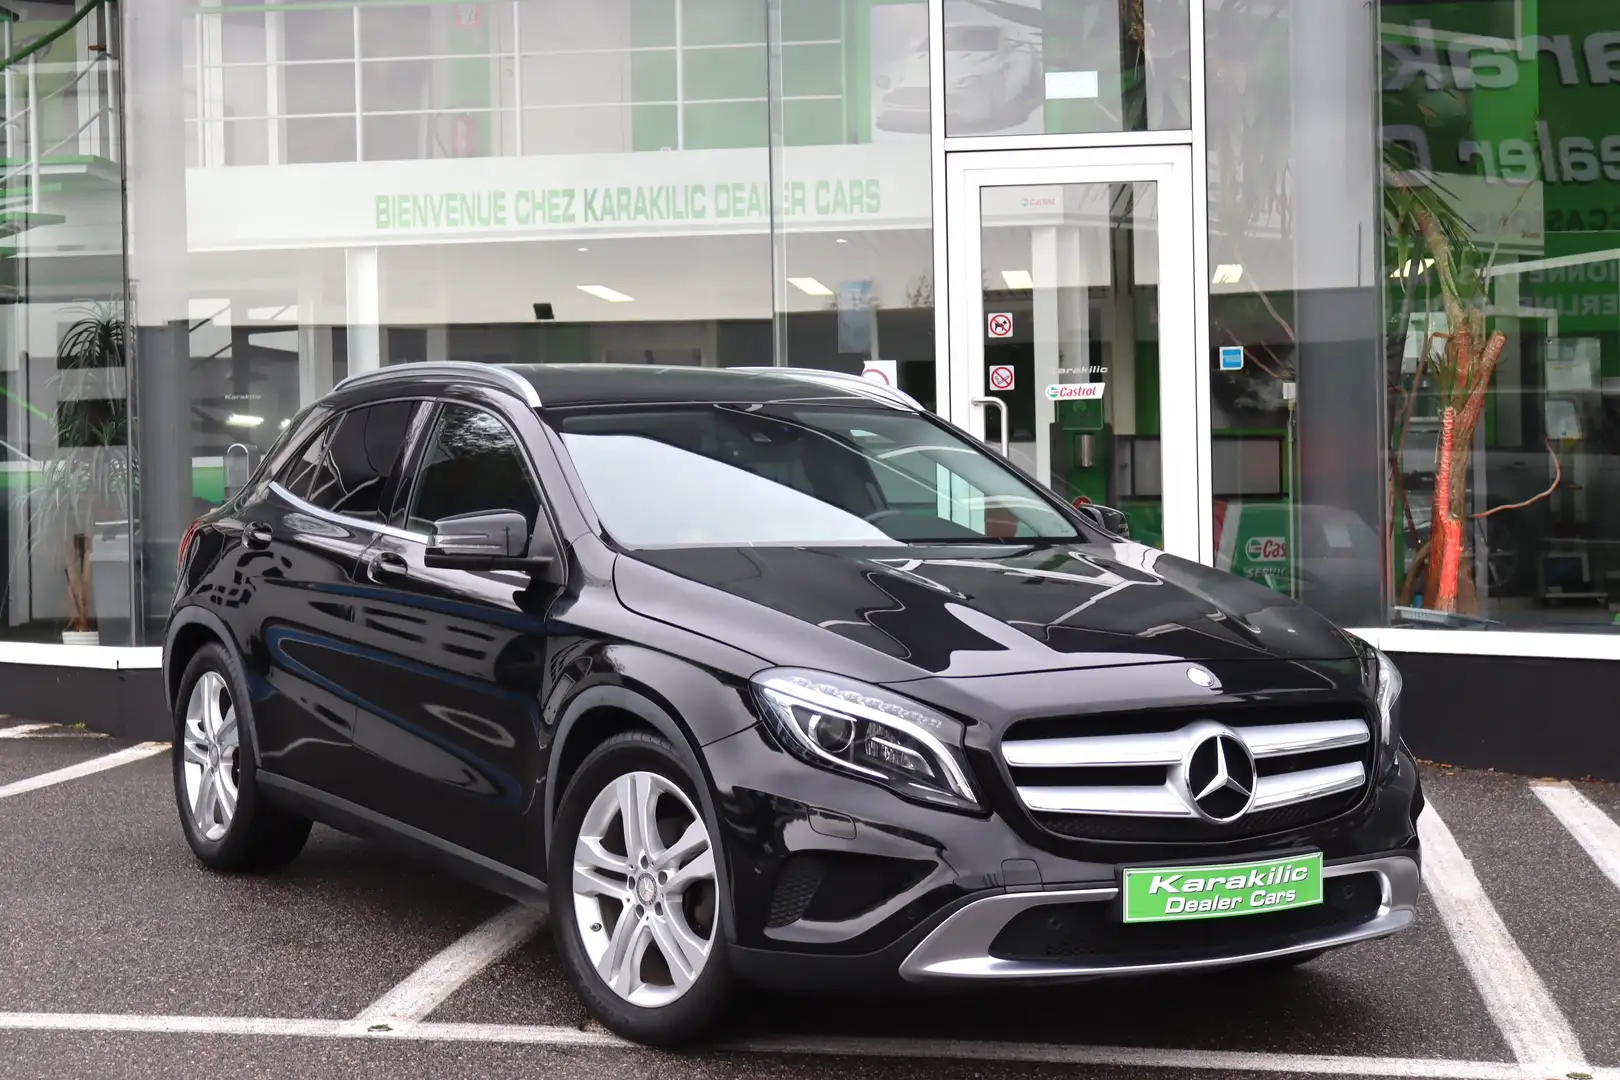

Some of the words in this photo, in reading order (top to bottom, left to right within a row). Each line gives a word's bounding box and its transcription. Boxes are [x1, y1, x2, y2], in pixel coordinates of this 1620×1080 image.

[375, 193, 507, 229] BIENVENUE
[515, 188, 576, 225] CHEZ
[584, 183, 706, 222] KARAKILIC
[815, 178, 881, 215] CARS
[1060, 386, 1096, 397] Castrol
[1149, 864, 1308, 894] Karakilic
[1165, 894, 1242, 914] Dealer
[1250, 889, 1296, 907] Cars
